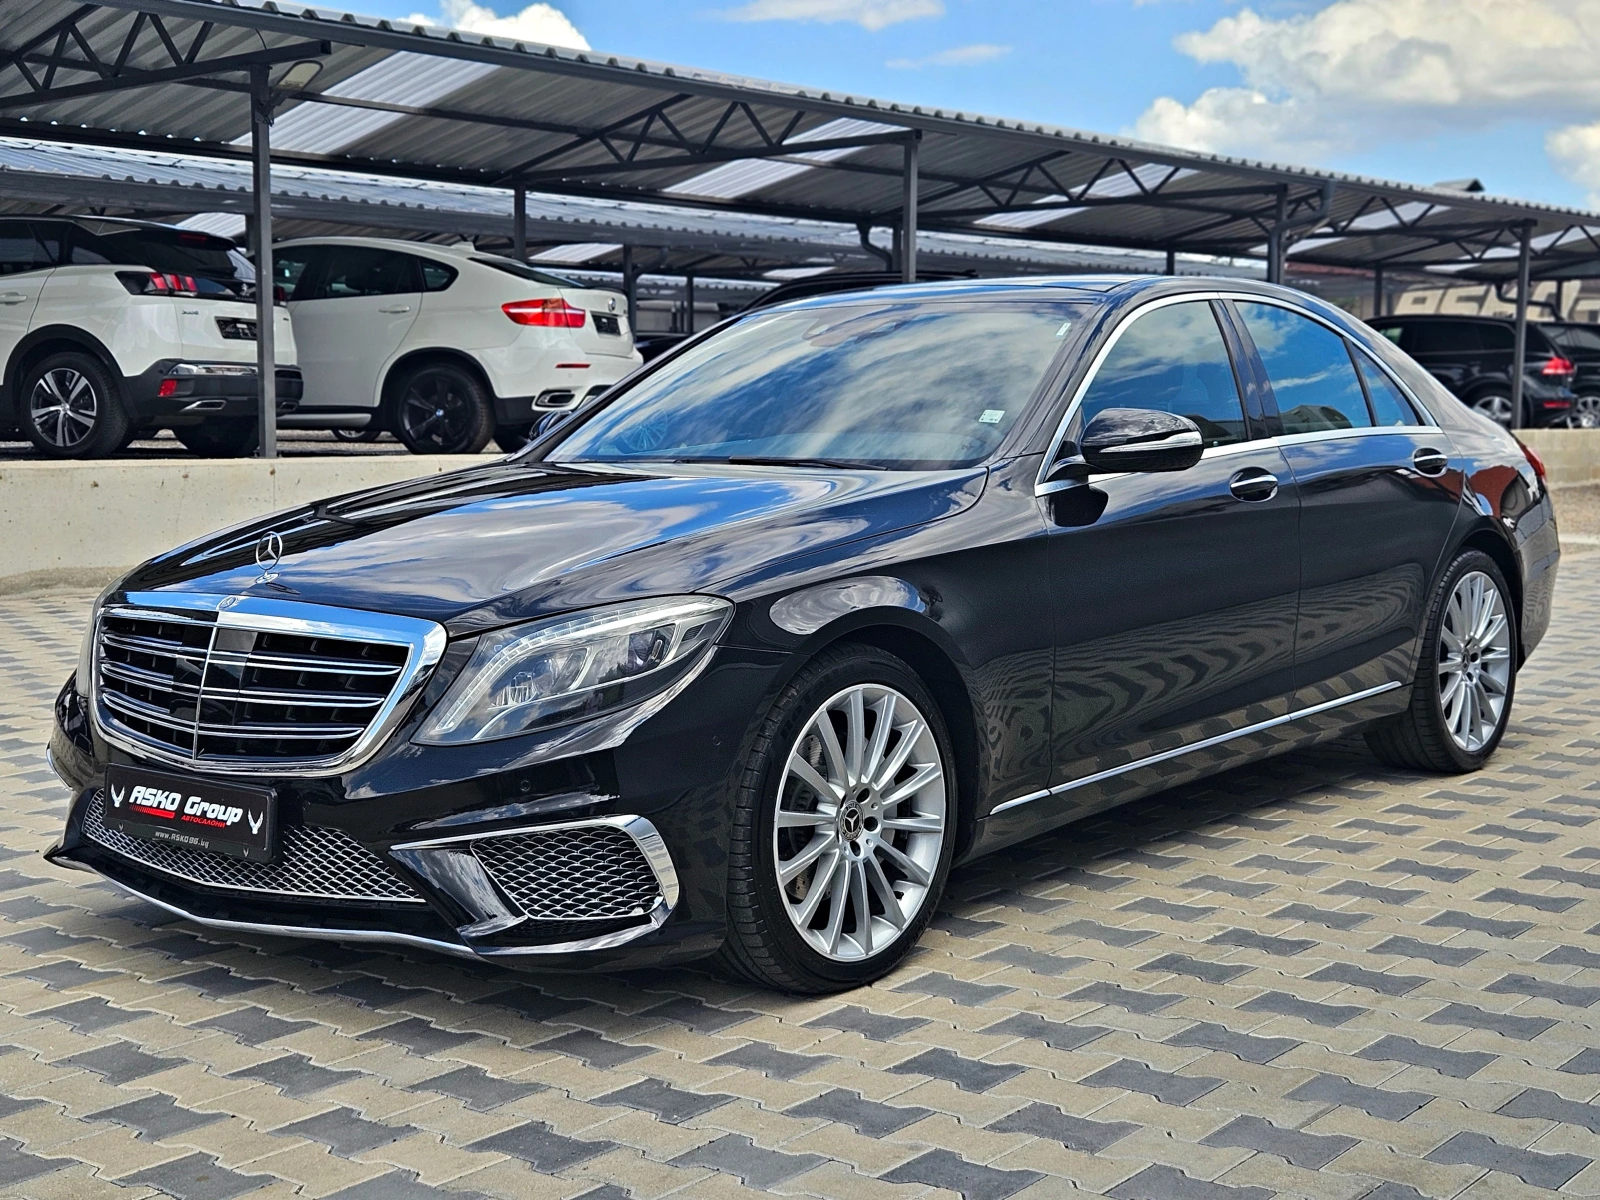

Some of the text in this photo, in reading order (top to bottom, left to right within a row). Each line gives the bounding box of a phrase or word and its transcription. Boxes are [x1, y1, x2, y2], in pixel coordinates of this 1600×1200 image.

[129, 785, 244, 826] ASKO Group
[181, 814, 226, 828] АВТОСАЛОНИ
